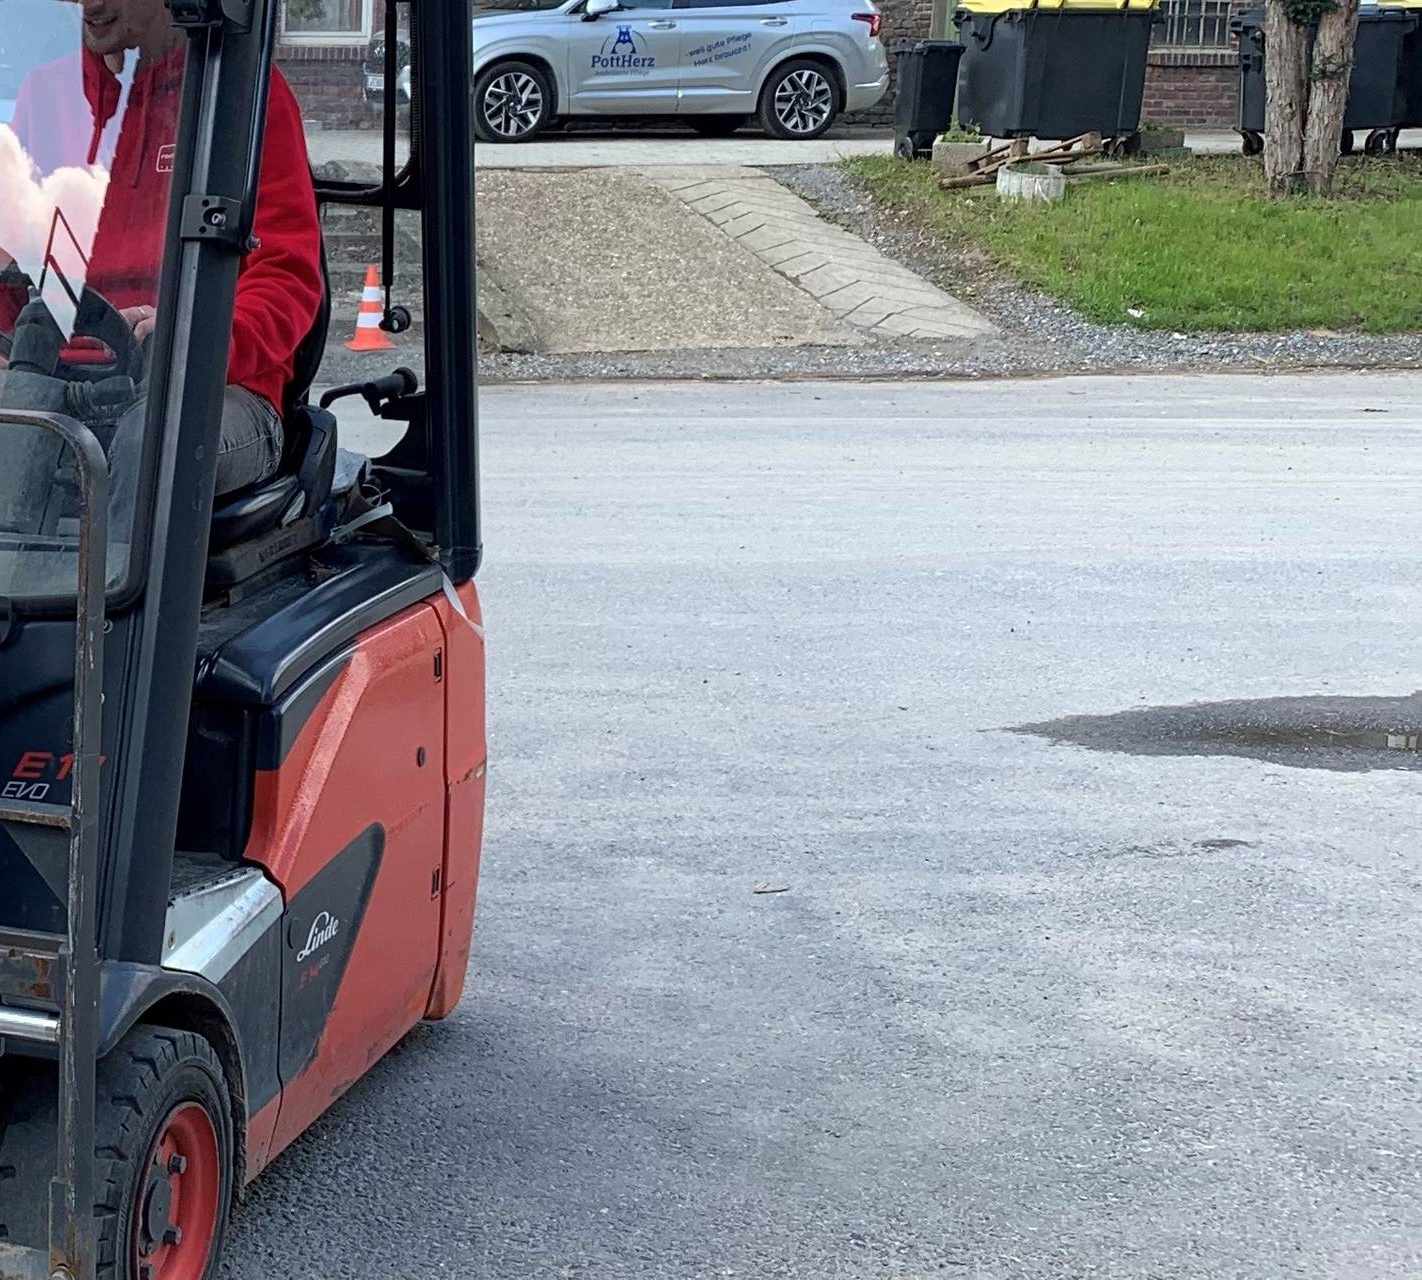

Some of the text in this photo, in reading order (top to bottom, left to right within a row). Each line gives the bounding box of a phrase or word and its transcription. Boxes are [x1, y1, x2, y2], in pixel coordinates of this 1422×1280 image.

[591, 55, 655, 68] PottHerz
[1, 781, 50, 799] EVO
[296, 911, 339, 962] Linde
